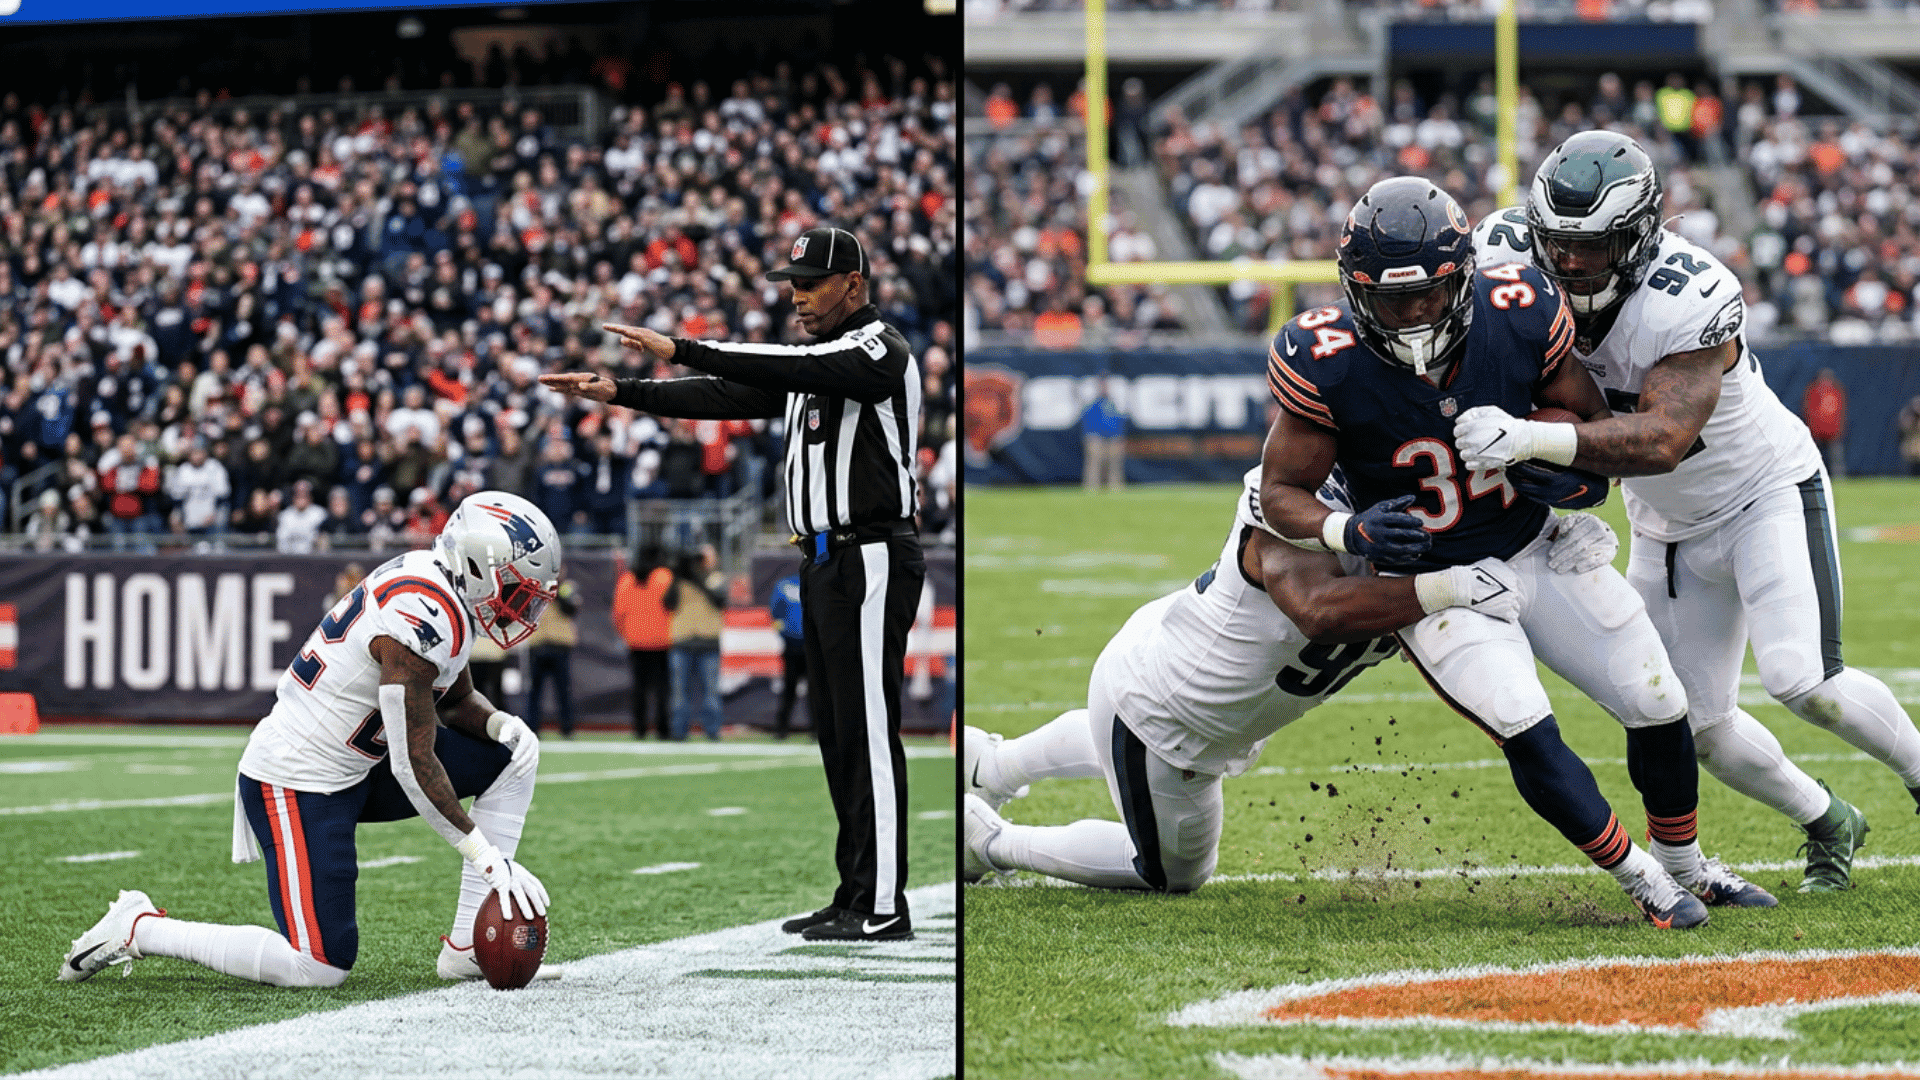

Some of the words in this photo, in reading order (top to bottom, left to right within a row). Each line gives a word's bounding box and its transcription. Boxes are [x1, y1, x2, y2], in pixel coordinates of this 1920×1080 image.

[1482, 262, 1536, 311] 34
[1648, 252, 1711, 296] 92
[1297, 306, 1356, 360] 34
[1391, 437, 1518, 532] 34
[63, 571, 295, 691] HOME
